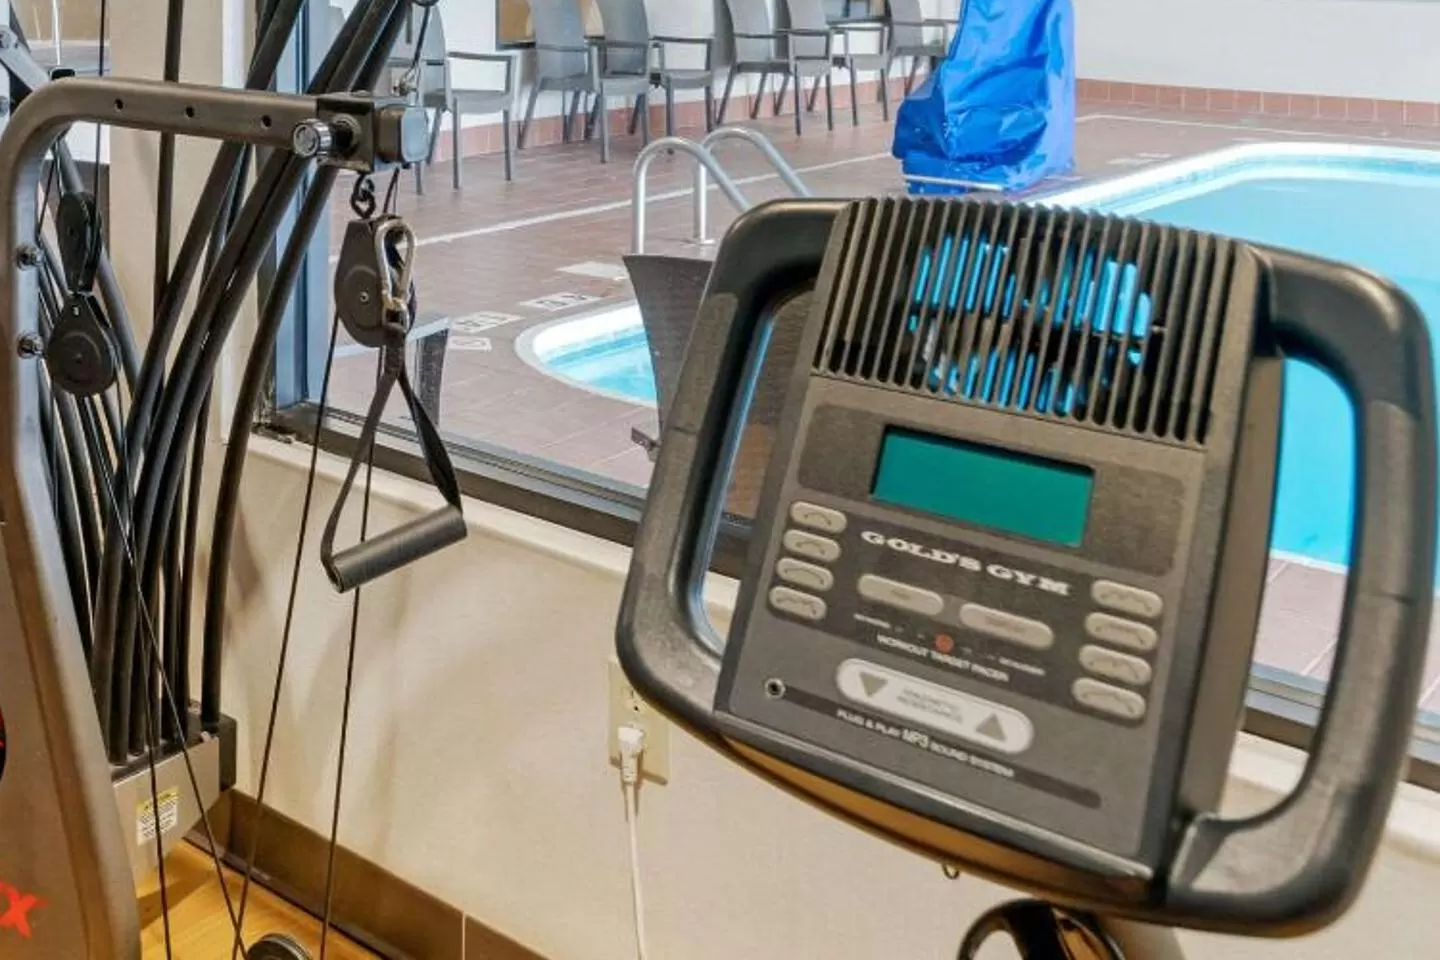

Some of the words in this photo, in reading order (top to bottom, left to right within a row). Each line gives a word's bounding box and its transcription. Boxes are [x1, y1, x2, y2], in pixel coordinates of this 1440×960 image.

[860, 530, 982, 572] GOLD'S
[986, 563, 1071, 596] GYM
[901, 727, 930, 749] MP3
